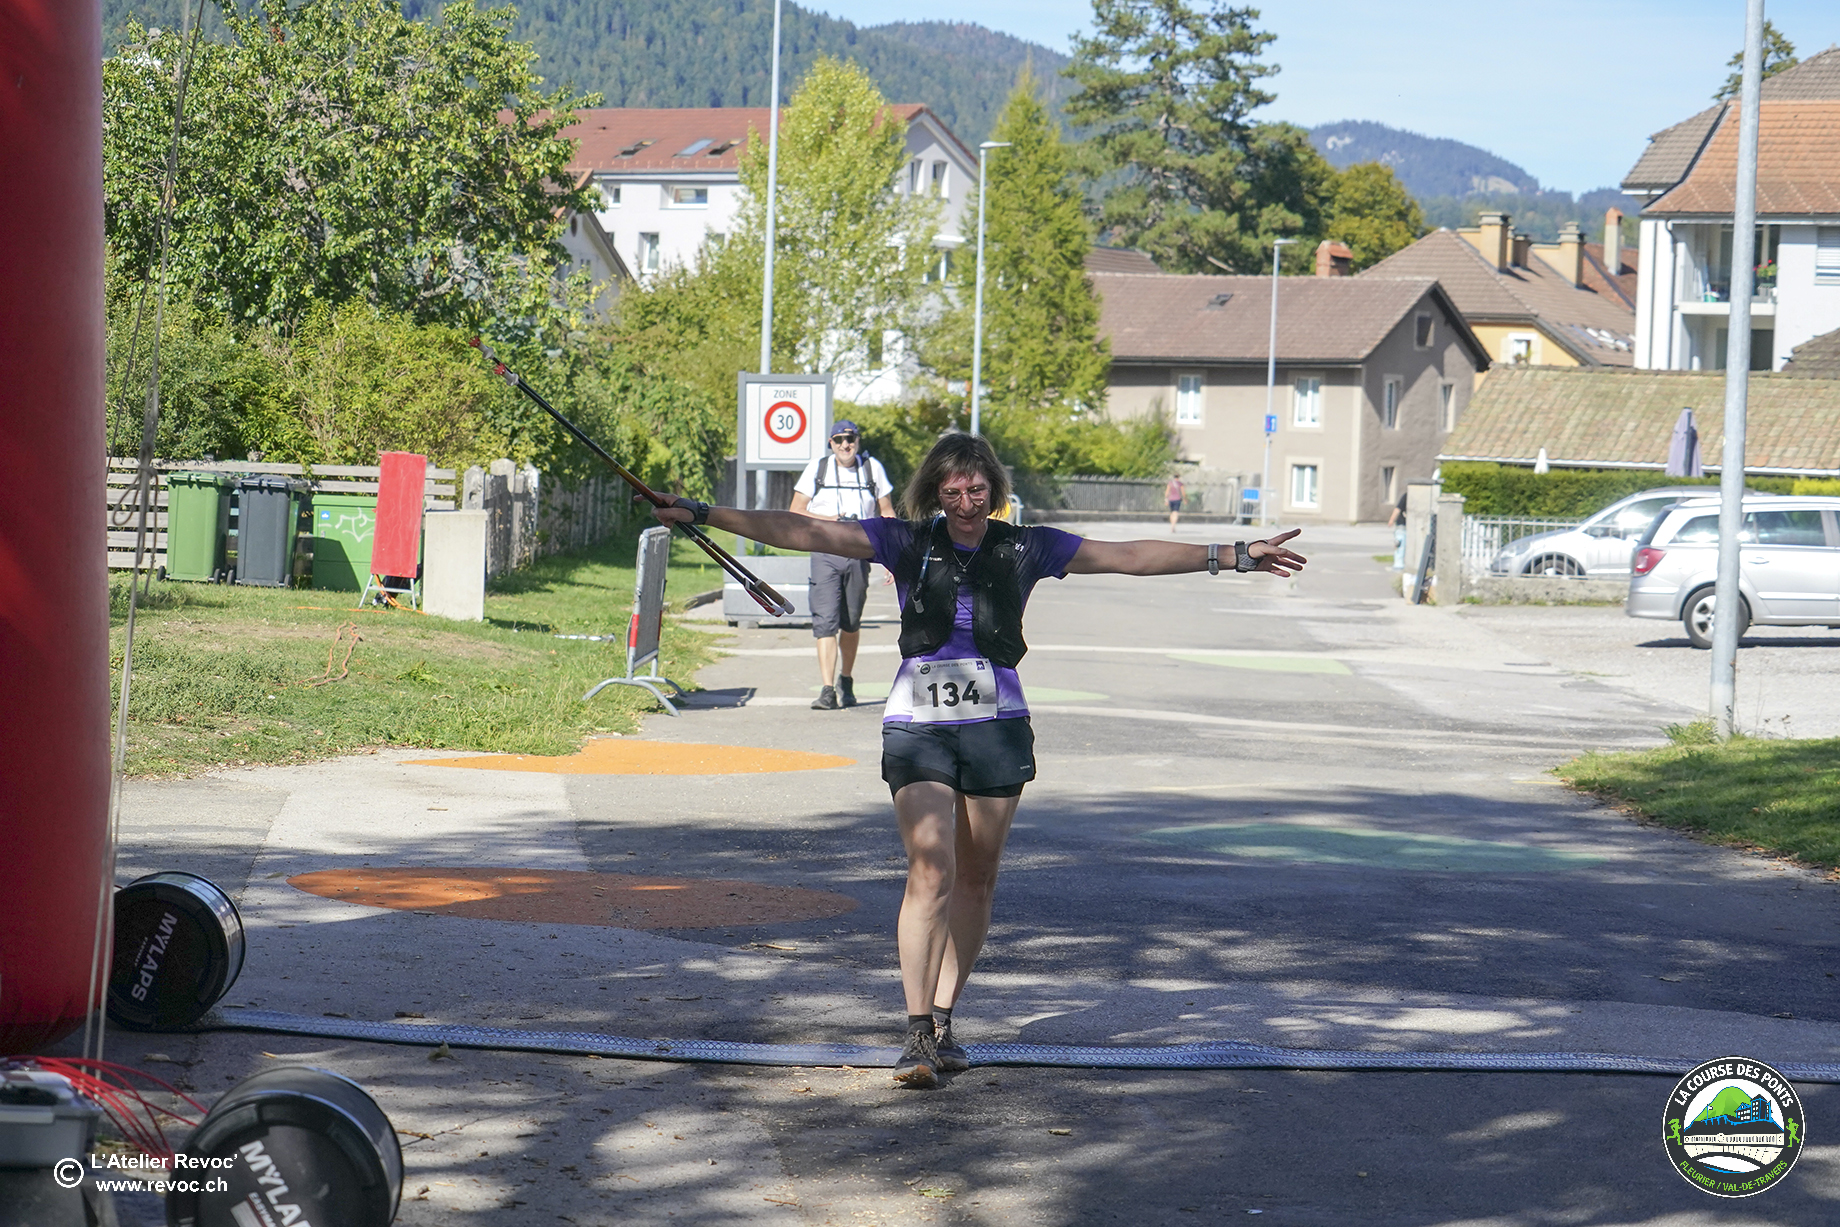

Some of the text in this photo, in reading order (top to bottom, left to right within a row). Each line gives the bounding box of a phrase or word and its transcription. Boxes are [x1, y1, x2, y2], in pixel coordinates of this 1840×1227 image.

[773, 389, 798, 398] ZONE
[776, 414, 794, 430] 30
[927, 680, 980, 708] 134
[131, 912, 178, 1002] MYLAPS
